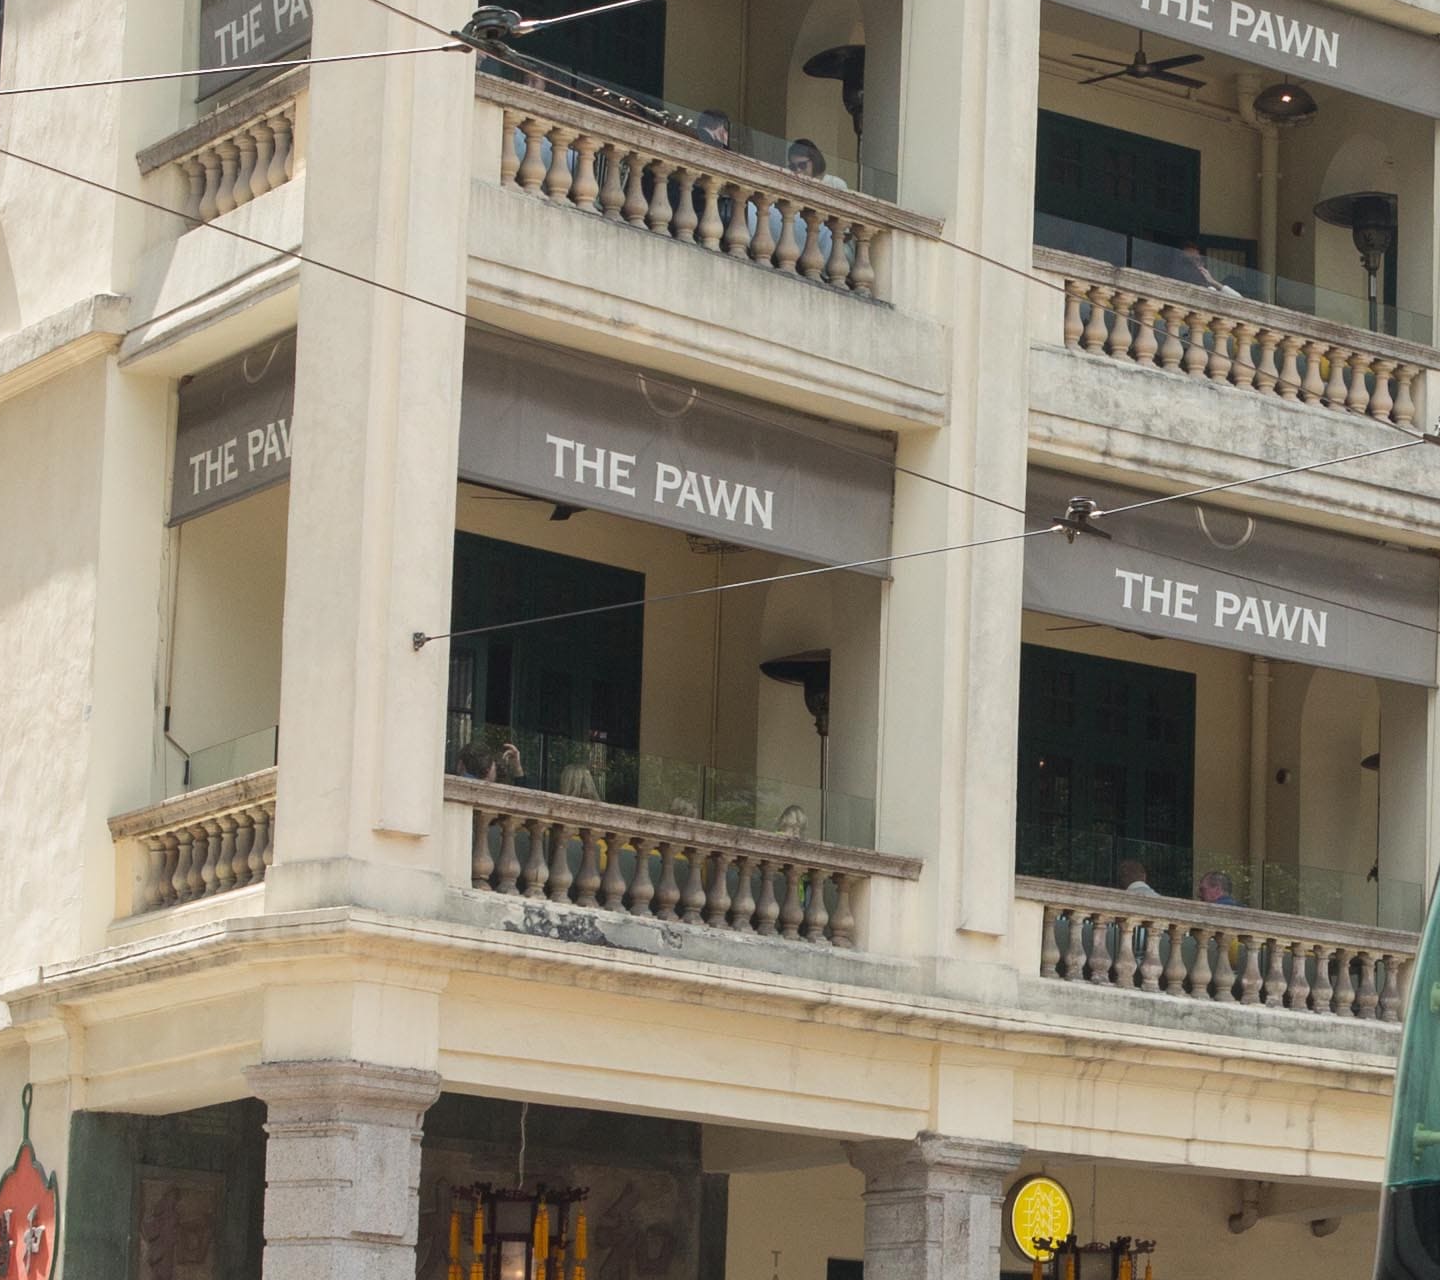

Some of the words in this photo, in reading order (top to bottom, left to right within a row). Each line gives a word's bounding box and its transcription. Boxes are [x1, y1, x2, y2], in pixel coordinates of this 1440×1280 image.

[214, 5, 264, 69] THE
[1229, 4, 1340, 69] PAWN
[190, 439, 239, 496] THE
[546, 435, 636, 500] THE
[656, 460, 775, 532] PAWN
[1115, 568, 1198, 623] THE
[1214, 591, 1328, 649] PAWN
